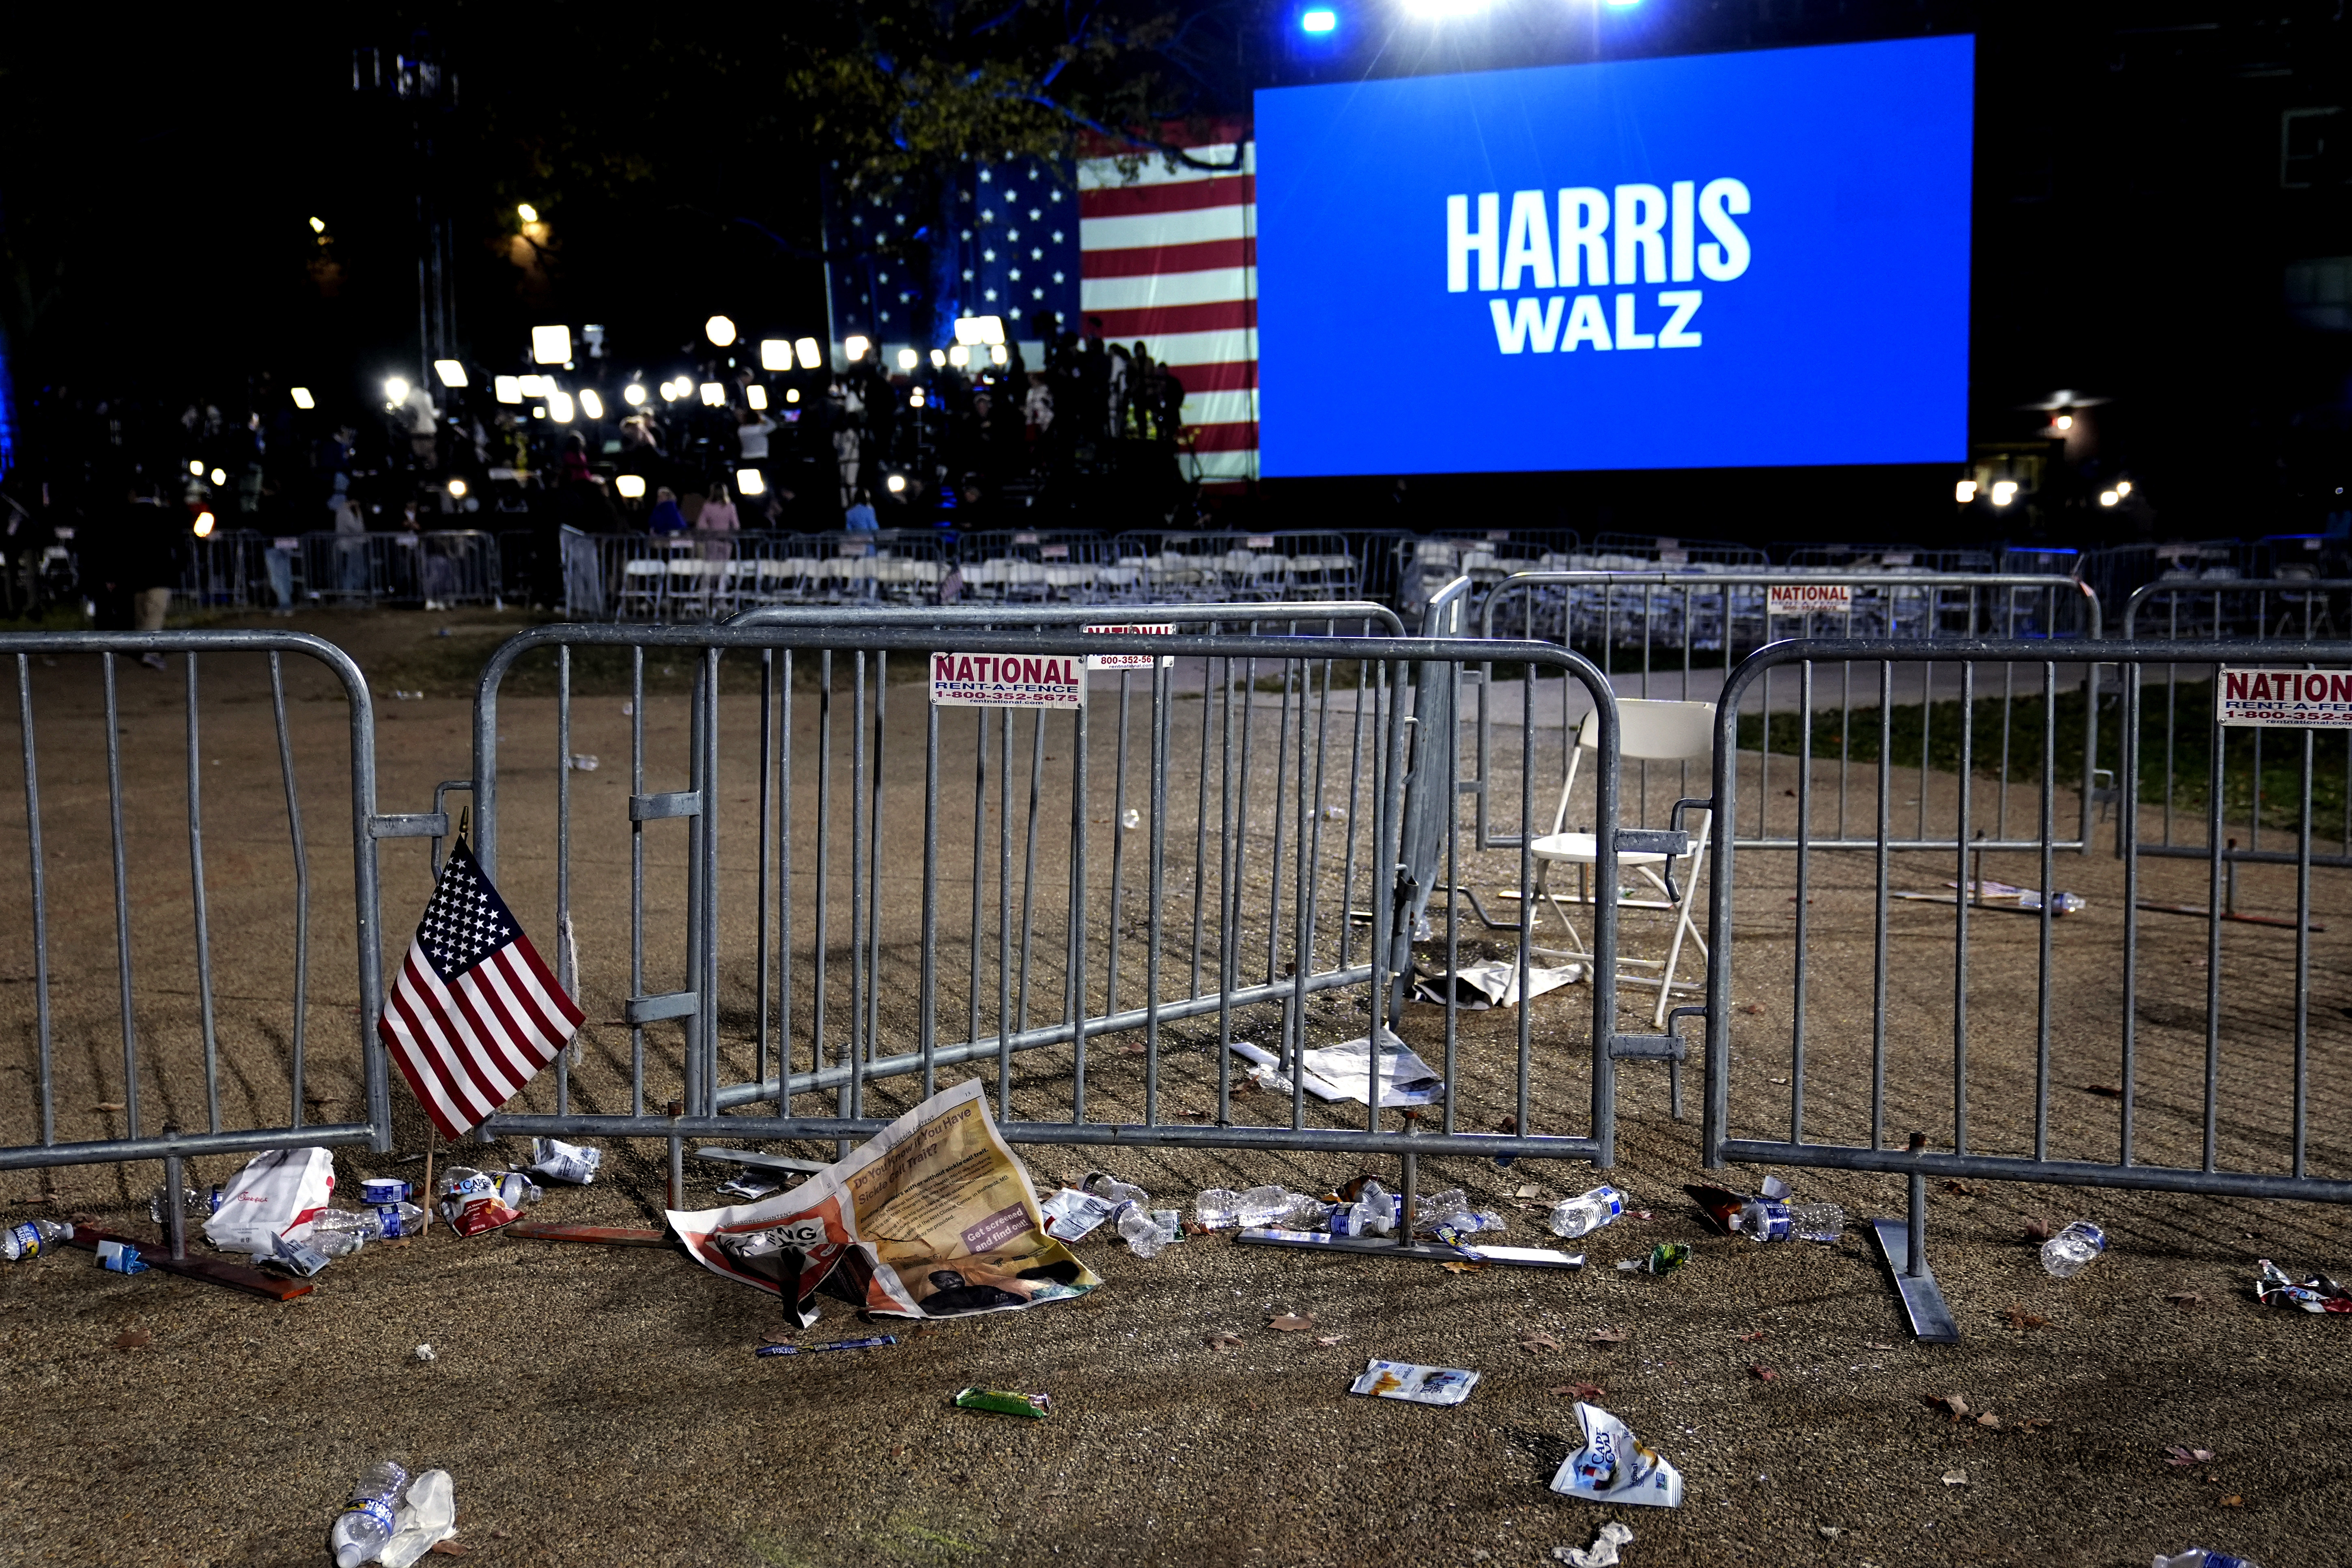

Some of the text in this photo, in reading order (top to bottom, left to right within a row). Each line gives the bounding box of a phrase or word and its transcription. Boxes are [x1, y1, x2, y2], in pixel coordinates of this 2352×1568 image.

[1446, 177, 1751, 293] HARRIS
[1489, 289, 1703, 354] WALZ
[1772, 587, 1848, 600] NATIONAL
[936, 656, 1078, 685] NATIONAL
[935, 682, 1078, 693] RENT-A-FENCE
[935, 691, 1078, 701] 1-800-352-5675
[885, 1115, 935, 1153] SPONSORED CONTENT
[854, 1108, 971, 1189] Do You Know if You Have
[859, 1143, 937, 1204] Sickle Cell Trait?
[904, 1184, 917, 1193] with
[923, 1169, 945, 1183] without
[945, 1162, 962, 1172] sickle
[963, 1155, 974, 1163] cell
[974, 1148, 989, 1157] trait.
[886, 1200, 906, 1213] National
[906, 1188, 928, 1202] Institutes
[933, 1178, 949, 1187] Health
[949, 1170, 962, 1179] (NIH)
[763, 1211, 792, 1221] CONTENT
[884, 1216, 892, 1224] cell
[902, 1199, 921, 1211] changes
[902, 1211, 916, 1220] sickle
[918, 1205, 938, 1219] provided
[930, 1213, 940, 1222] NIH
[939, 1204, 958, 1215] Clinical
[956, 1196, 973, 1206] Center
[934, 1214, 955, 1230] provided.
[14, 1227, 27, 1246] PARK
[21, 1225, 34, 1243] DEER
[967, 1207, 1023, 1241] Get screened
[975, 1219, 1029, 1252] and find out!
